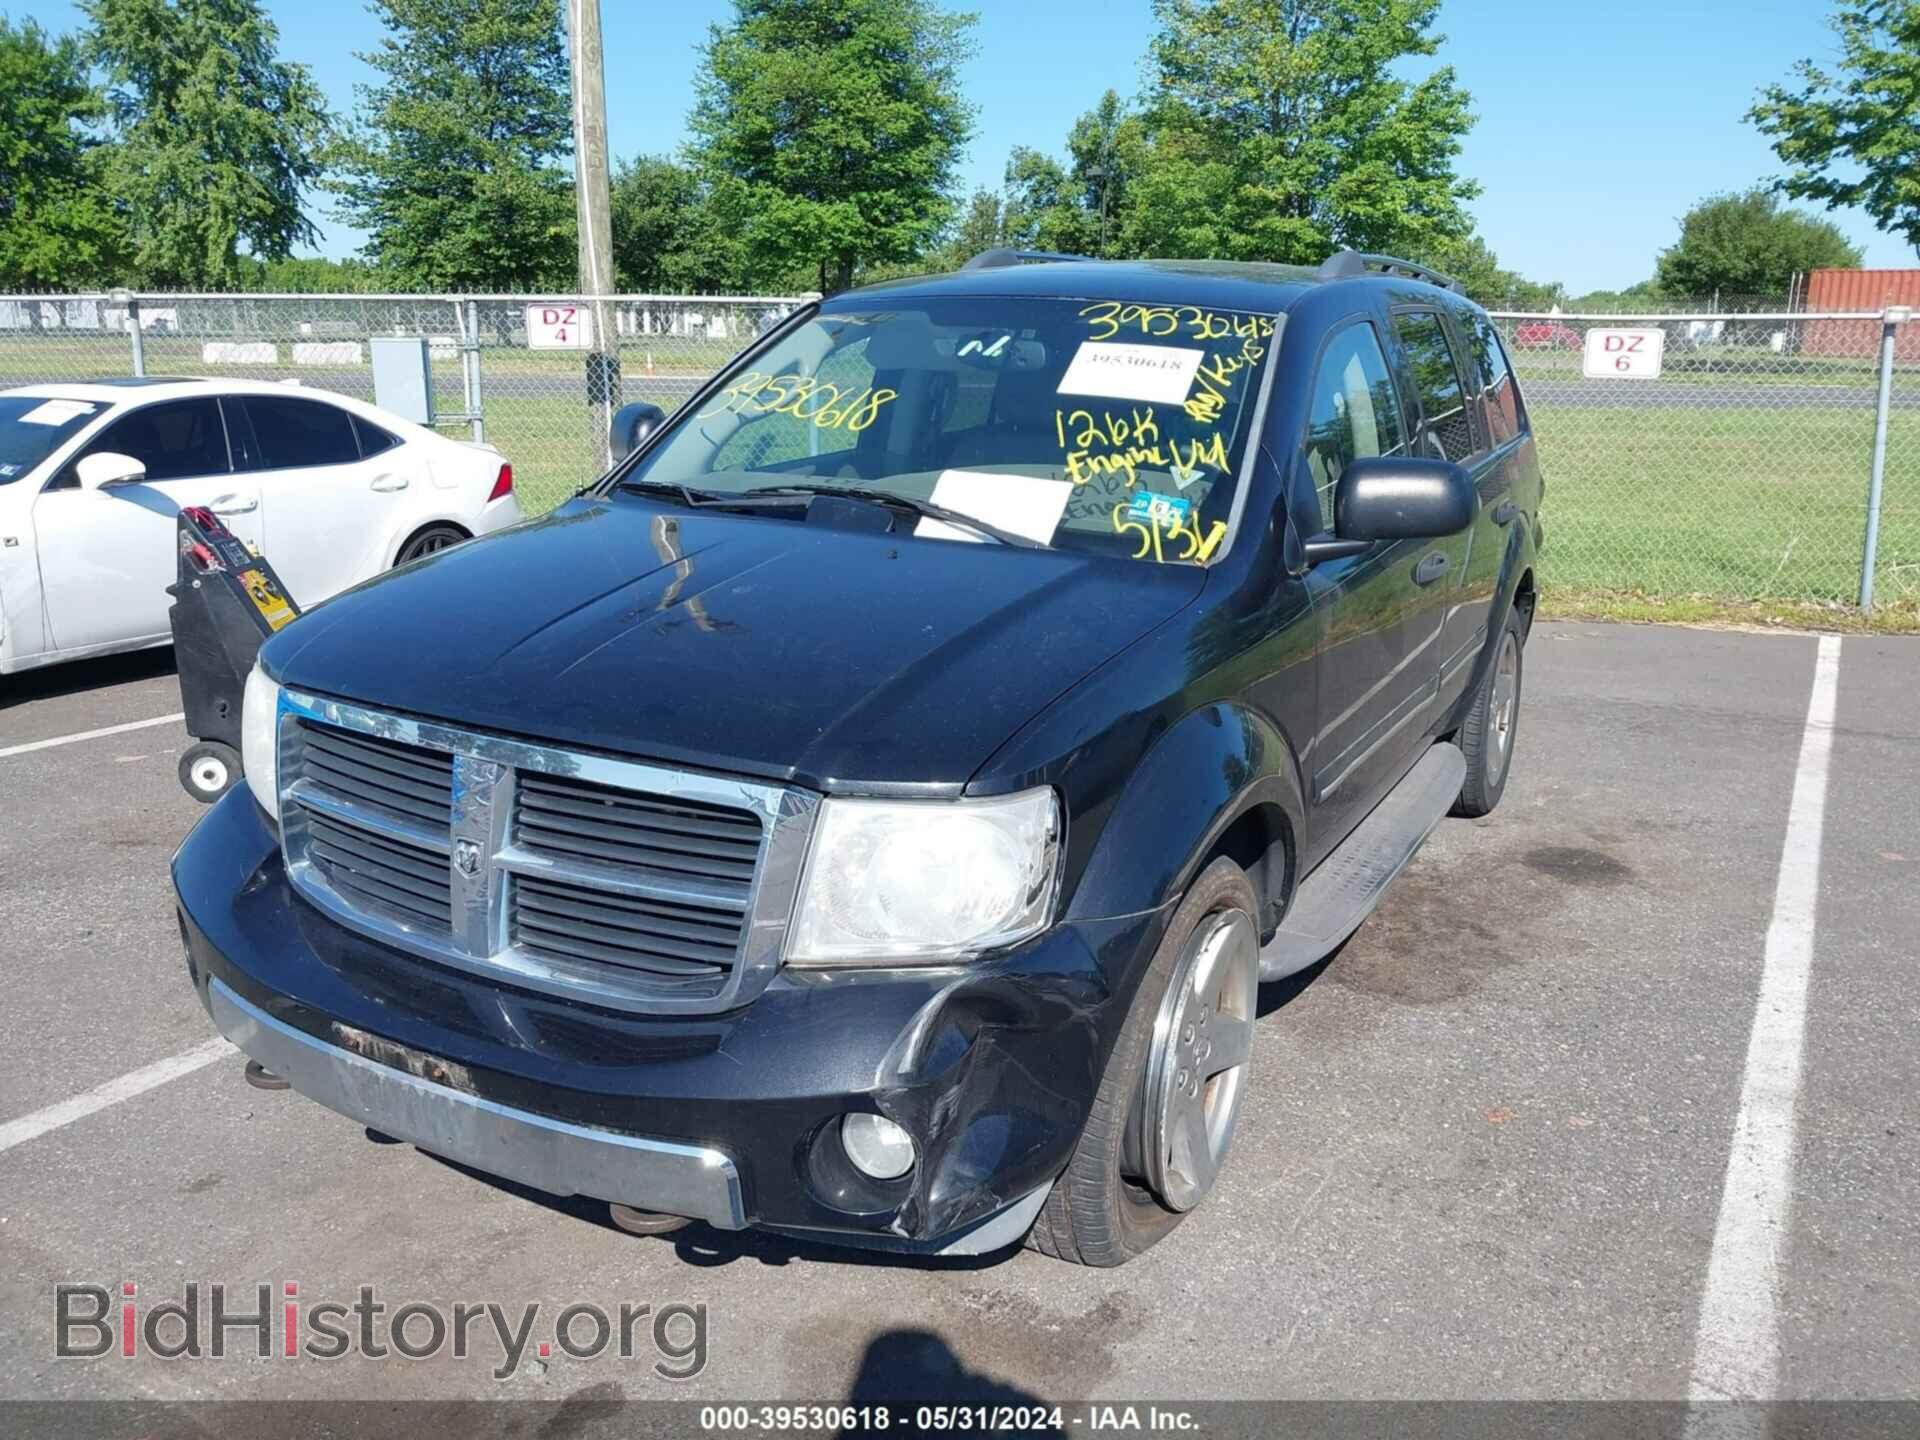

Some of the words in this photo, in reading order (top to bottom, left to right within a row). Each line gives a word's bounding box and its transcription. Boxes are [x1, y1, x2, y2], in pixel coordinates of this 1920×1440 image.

[542, 308, 577, 326] DZ
[555, 328, 567, 342] 4
[1604, 335, 1645, 353] DZ
[1615, 354, 1631, 372] 6
